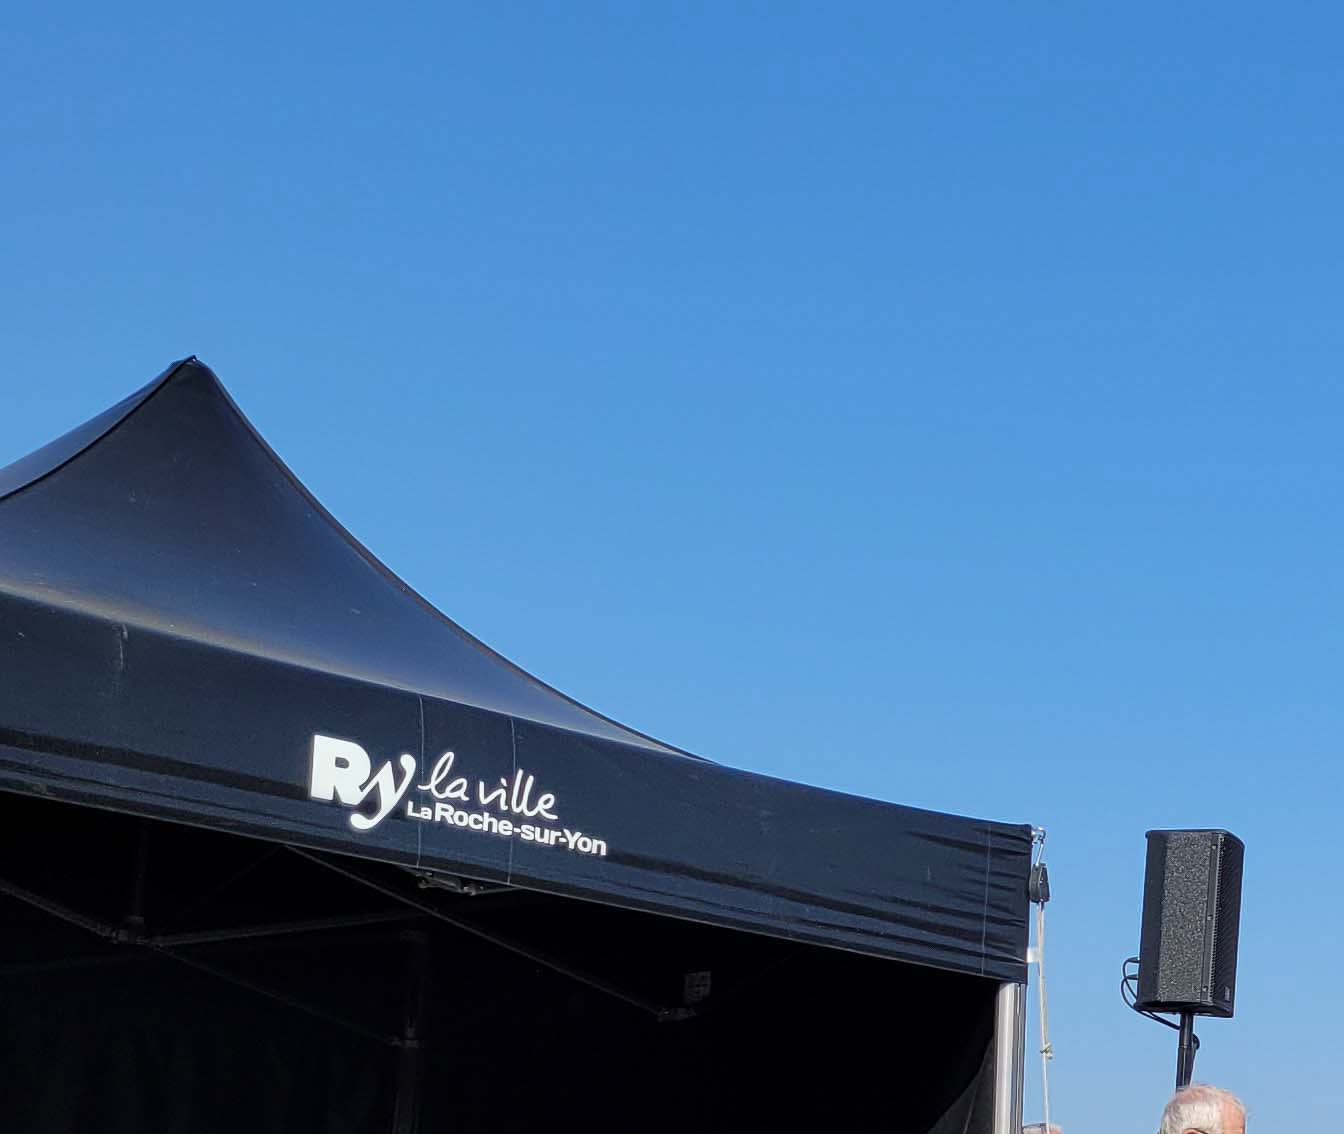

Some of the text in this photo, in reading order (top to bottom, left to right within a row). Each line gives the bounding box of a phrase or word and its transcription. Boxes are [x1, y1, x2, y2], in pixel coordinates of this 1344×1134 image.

[309, 734, 416, 830] Ry
[417, 751, 559, 820] la ville
[434, 801, 608, 857] Roche-sur-Yon
